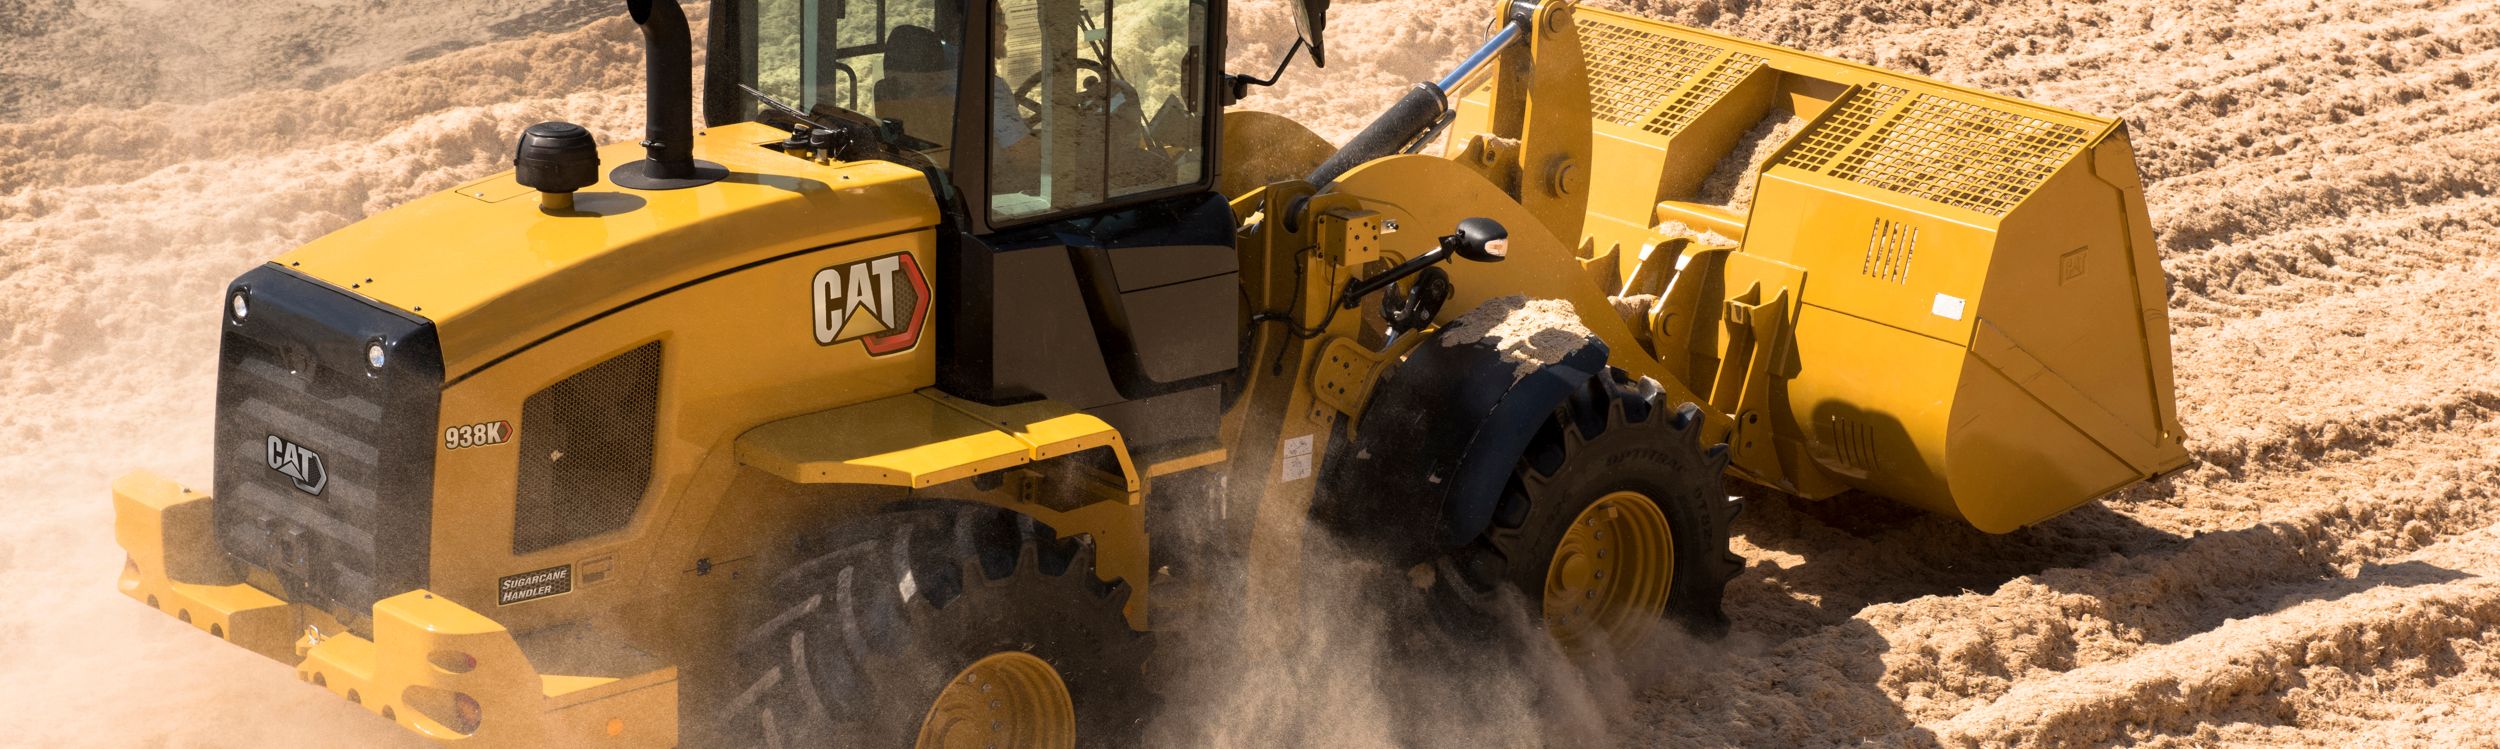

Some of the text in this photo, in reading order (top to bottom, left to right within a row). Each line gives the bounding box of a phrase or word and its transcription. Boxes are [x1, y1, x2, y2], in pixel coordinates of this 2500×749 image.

[813, 255, 900, 343] CAT
[445, 421, 502, 449] 938K
[267, 435, 313, 482] CAT
[502, 569, 567, 590] SUGARCANE
[502, 584, 552, 602] HANDLER
